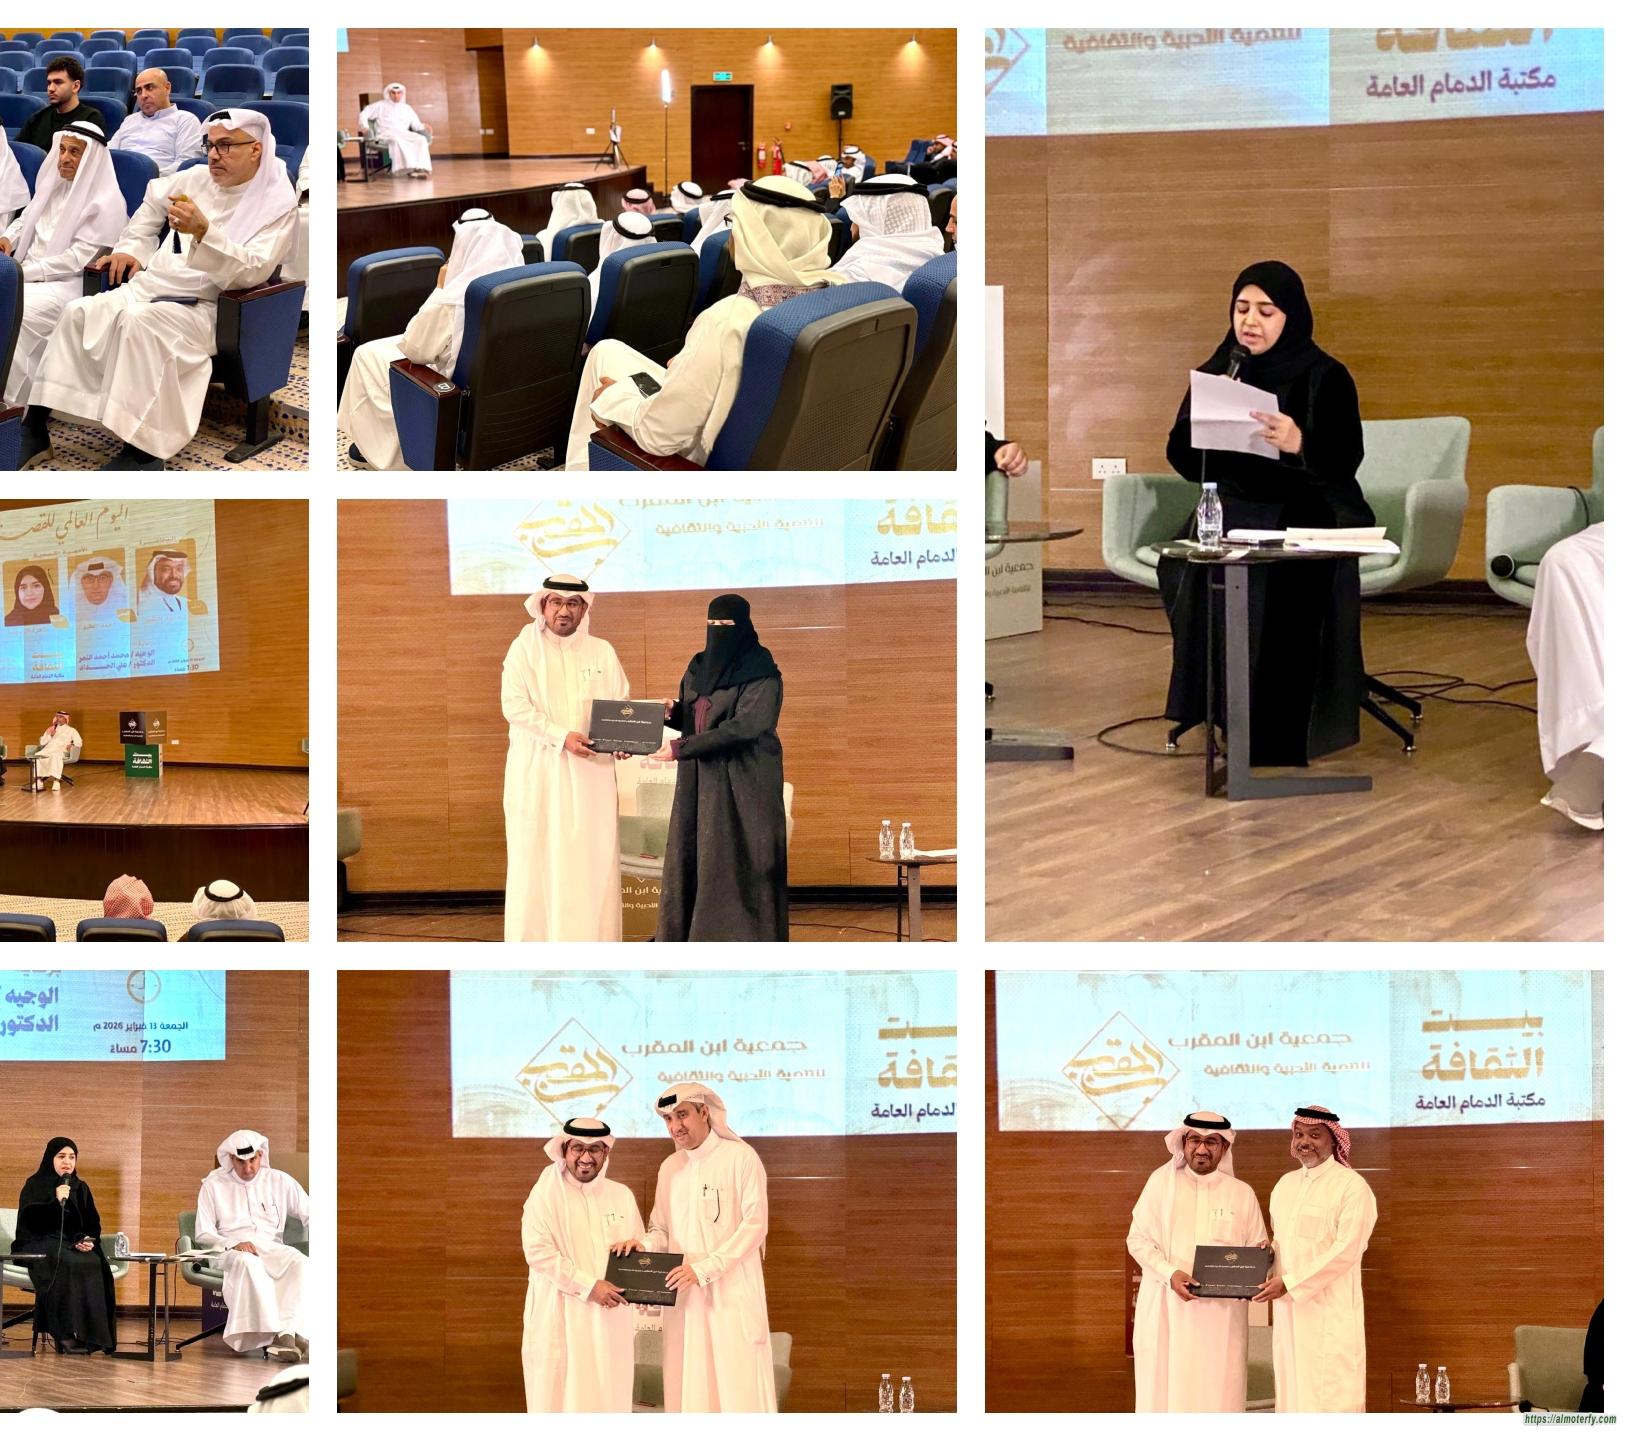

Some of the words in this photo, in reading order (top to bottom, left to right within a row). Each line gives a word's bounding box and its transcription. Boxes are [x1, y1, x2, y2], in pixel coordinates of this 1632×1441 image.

[1366, 73, 1425, 98] العامة
[1429, 70, 1492, 103] الدمام
[1497, 66, 1557, 96] مكتبة
[55, 511, 94, 546] العالمي
[95, 503, 129, 540] اليوم
[871, 550, 912, 566] العامة
[917, 548, 957, 570] لدمام
[1005, 562, 1035, 577] جمعية
[635, 886, 649, 896] ابن
[5, 986, 60, 1009] الوجيه
[93, 1023, 101, 1032] م
[103, 1022, 124, 1030] 2026
[125, 1021, 147, 1033] فبراير
[149, 1022, 158, 1030] 13
[160, 1021, 188, 1032] الجمعة
[1421, 1010, 1544, 1038] بيت
[140, 1039, 172, 1054] 7:30
[622, 1039, 695, 1057] المقرب
[700, 1039, 728, 1057] ابن
[733, 1038, 808, 1056] جمعية
[1168, 1033, 1241, 1051] المقرب
[1246, 1032, 1273, 1050] ابن
[1279, 1031, 1353, 1048] جمعية
[1204, 1063, 1271, 1078] والثقافية
[1421, 1041, 1545, 1082] الثقافة
[657, 1070, 725, 1085] والثقافية
[1415, 1095, 1457, 1111] العامة
[1459, 1094, 1503, 1115] الدمام
[1506, 1091, 1546, 1111] مكتبة
[871, 1103, 913, 1118] العامة
[916, 1102, 957, 1123] لدمام
